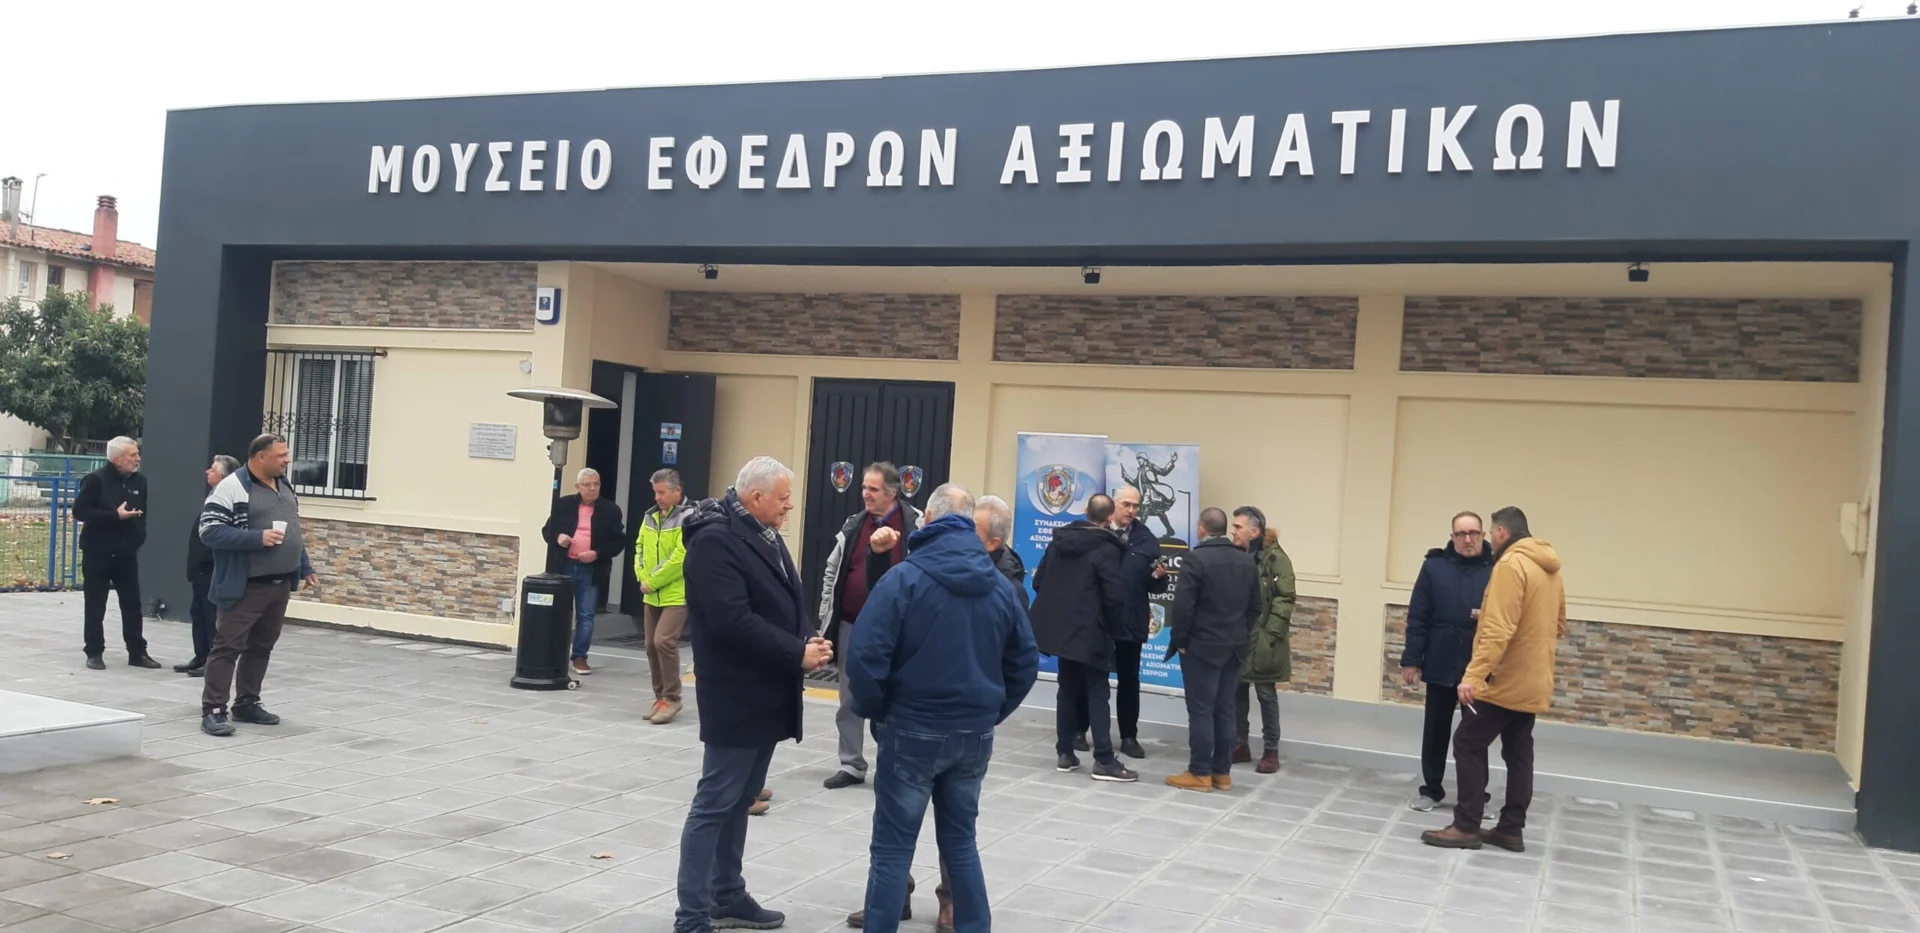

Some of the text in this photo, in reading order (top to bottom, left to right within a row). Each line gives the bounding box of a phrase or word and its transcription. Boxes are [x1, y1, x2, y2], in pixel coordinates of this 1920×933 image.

[367, 99, 1621, 193] ΜΟΥΣΕΙΟ ΕΦΕΔΡΩΝ ΑΞΙΩΜΑΤΙΚΩΝ
